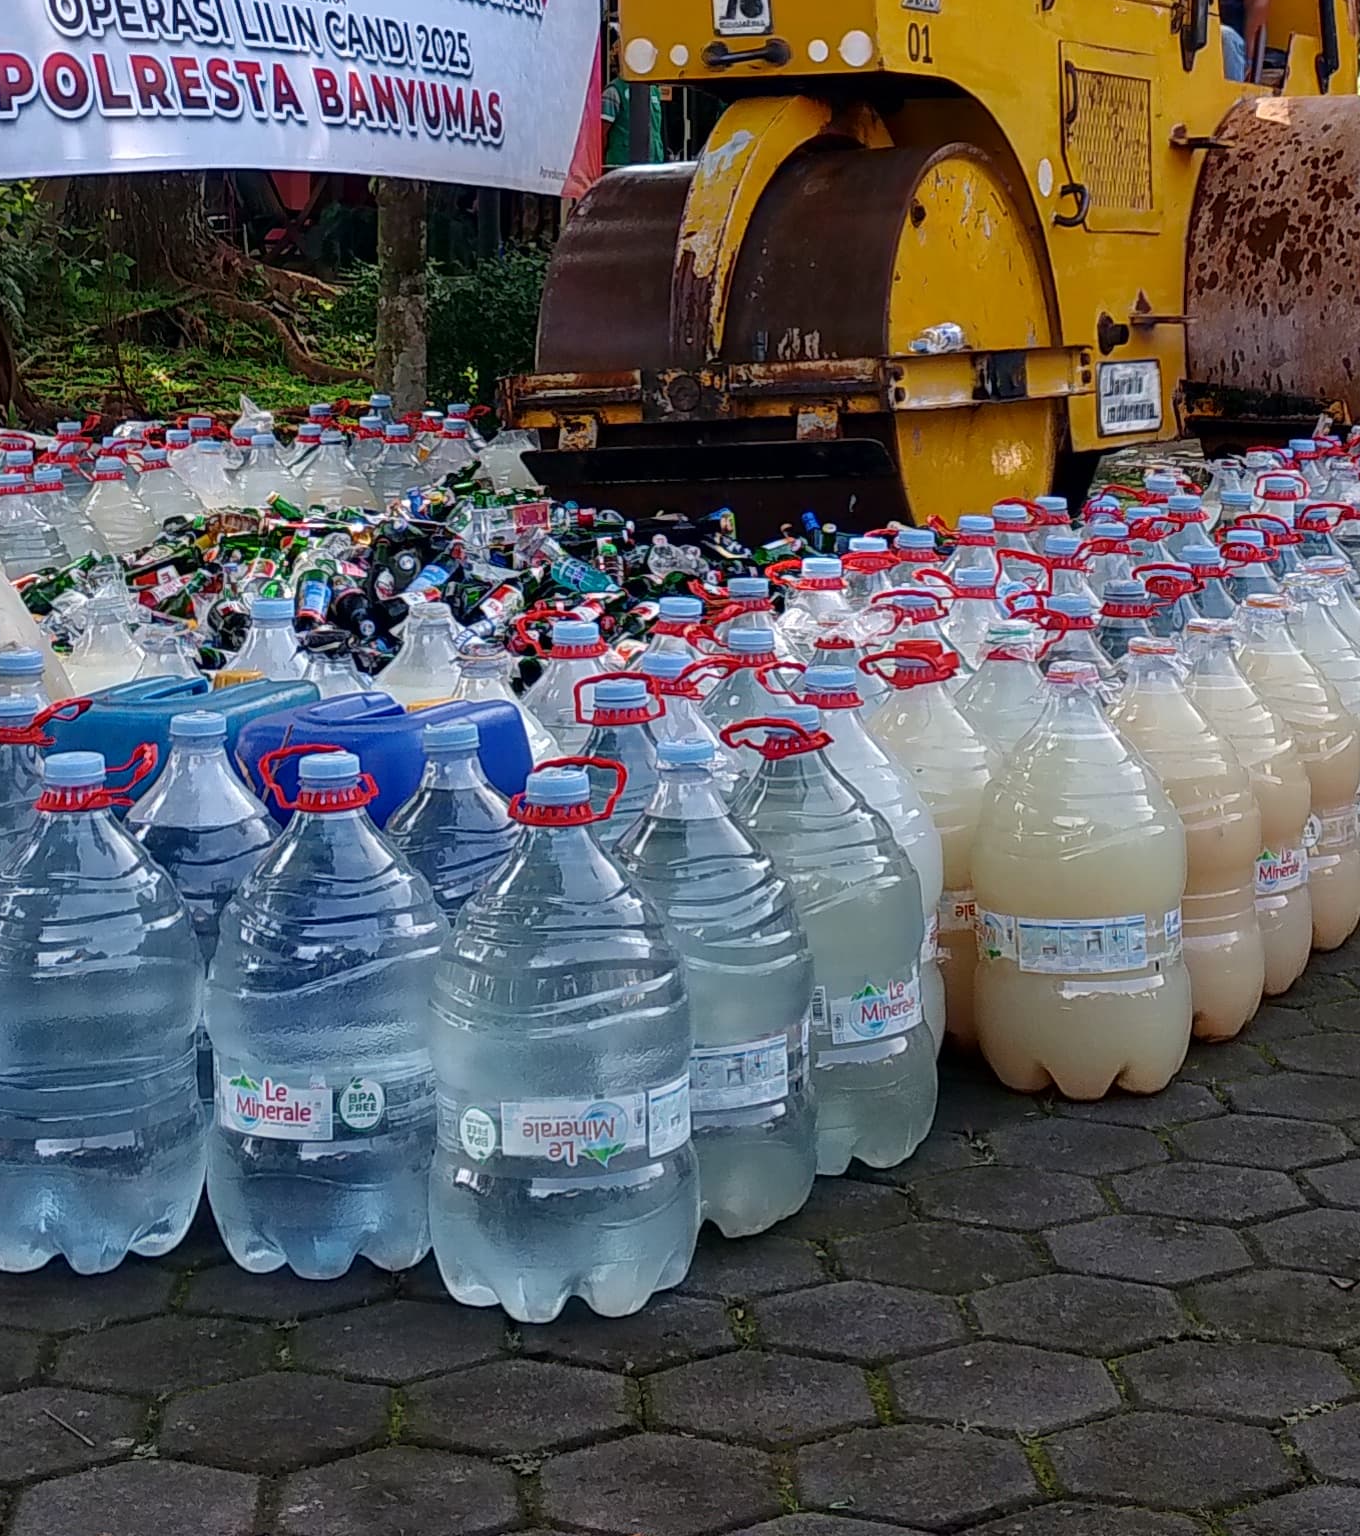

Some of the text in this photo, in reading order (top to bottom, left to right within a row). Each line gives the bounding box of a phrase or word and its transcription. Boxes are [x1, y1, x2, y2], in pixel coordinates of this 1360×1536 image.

[324, 10, 412, 64] CANDI
[415, 24, 471, 72] 2025
[907, 22, 933, 64] 01
[312, 66, 504, 141] BANYUMAS
[888, 980, 905, 1001] Le
[264, 1078, 288, 1102] Le
[348, 1092, 377, 1104] BPA
[236, 1091, 312, 1122] Minerale
[348, 1102, 377, 1112] FREE
[522, 1117, 616, 1145] Minerale
[548, 1141, 575, 1164] Le
